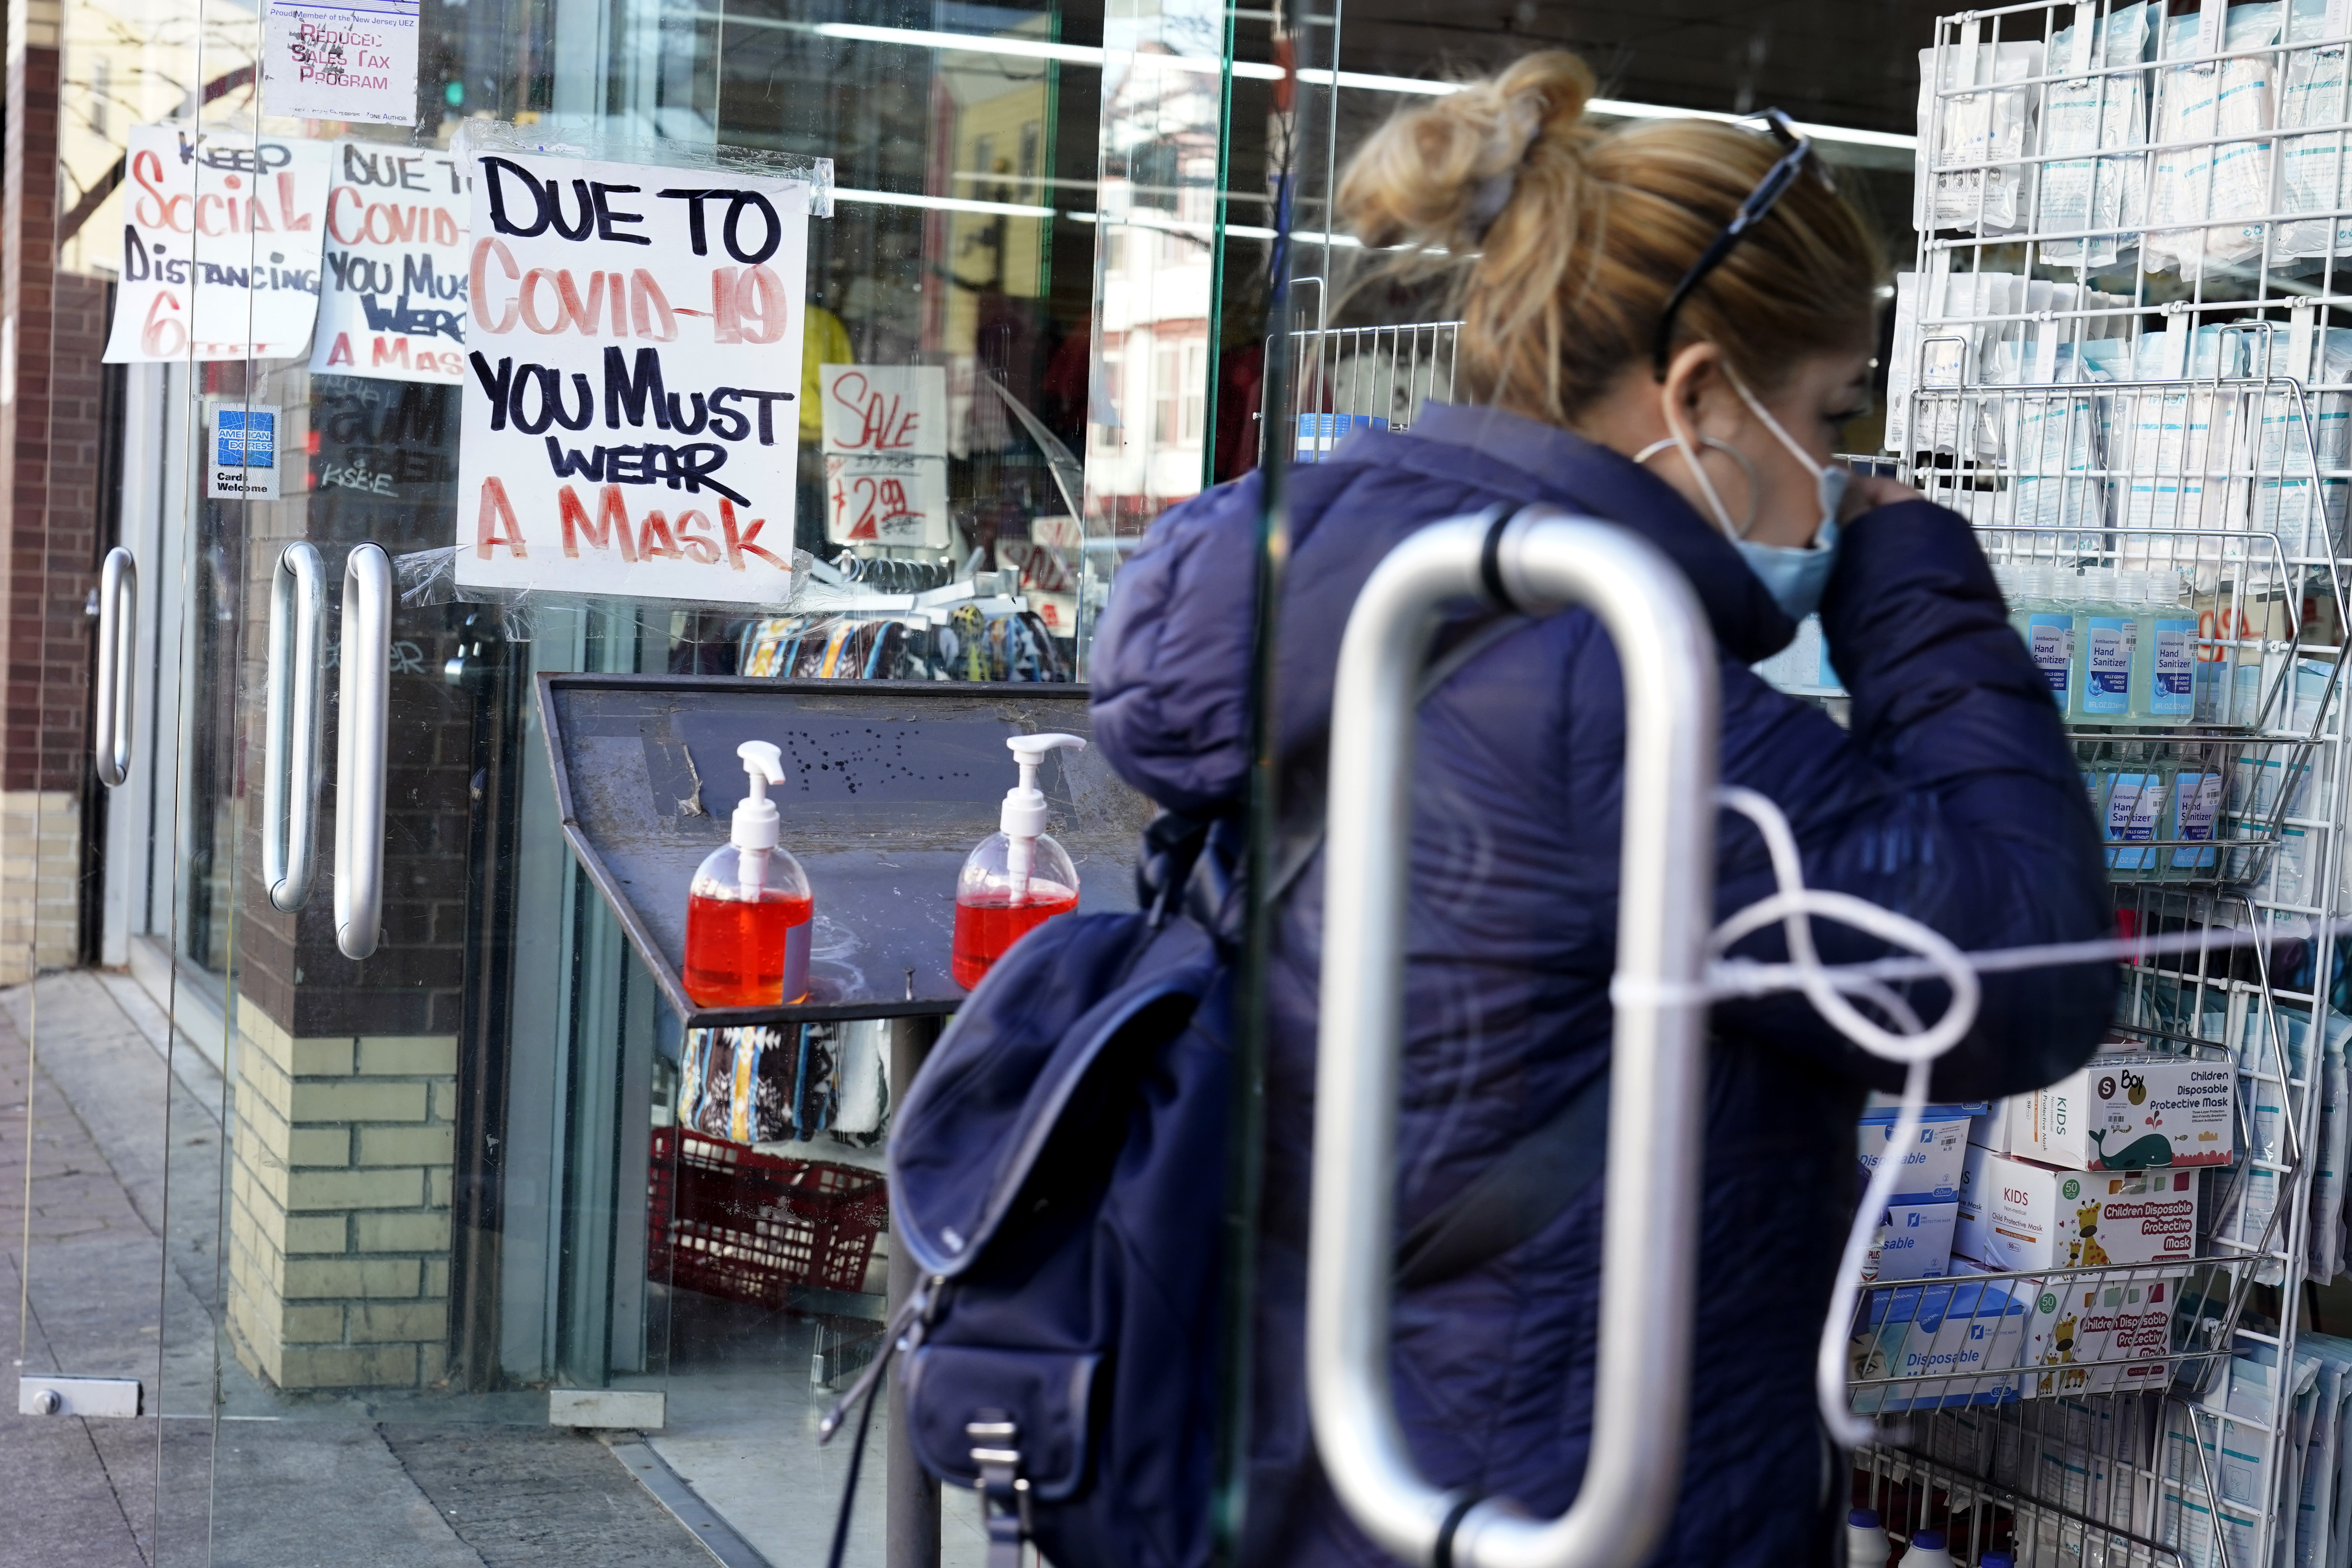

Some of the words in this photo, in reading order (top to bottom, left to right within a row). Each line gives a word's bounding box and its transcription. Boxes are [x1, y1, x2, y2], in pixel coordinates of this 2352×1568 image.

[270, 9, 292, 17] Proud
[295, 10, 327, 20] Member
[372, 17, 397, 27] Jersey
[291, 44, 347, 65] SALES
[358, 49, 390, 69] TAX
[300, 65, 387, 90] PROGRAM
[179, 131, 291, 175] KEEP
[344, 144, 431, 192] DUE
[478, 156, 652, 245] DUE
[656, 188, 781, 265] TO
[327, 250, 393, 295] YOU
[141, 290, 186, 358] 6
[326, 331, 355, 367] A
[469, 350, 593, 434] YOU
[604, 345, 795, 446] MUST
[832, 370, 919, 451] SALE
[217, 472, 248, 481] Cards
[546, 435, 751, 507] WEAR
[217, 482, 267, 493] Welcome
[477, 476, 527, 560] A
[2035, 644, 2054, 653] Hand
[2094, 647, 2114, 656] Hand
[2160, 649, 2179, 657] Hand
[2034, 655, 2065, 664] Sanitizer
[2093, 657, 2126, 666] Sanitizer
[2159, 660, 2190, 668] Sanitizer
[2182, 802, 2201, 811] Hnd
[2113, 813, 2150, 822] Santizer
[2121, 1069, 2144, 1096] Boy
[2191, 1071, 2228, 1081] Children
[2102, 1080, 2112, 1095] S
[2177, 1083, 2228, 1097] Disposable
[2027, 1100, 2031, 1109] 50
[2150, 1098, 2200, 1110] Protective
[2202, 1097, 2228, 1107] Mask
[2056, 1097, 2067, 1135] KIDS
[2065, 1182, 2077, 1193] 50
[2004, 1187, 2029, 1206] KIDS
[1967, 1200, 1982, 1211] Mask
[2004, 1205, 2027, 1216] Non-medical
[2106, 1205, 2143, 1217] Children
[2145, 1202, 2192, 1217] Disposable
[1992, 1212, 2003, 1222] Child
[2004, 1216, 2027, 1229] Protective
[2027, 1223, 2043, 1232] Mask
[2143, 1220, 2191, 1233] Protective
[2166, 1237, 2190, 1248] Mask
[1868, 1250, 1880, 1259] PLUS
[2042, 1296, 2054, 1307] 50
[2120, 1315, 2166, 1330] Dispsable
